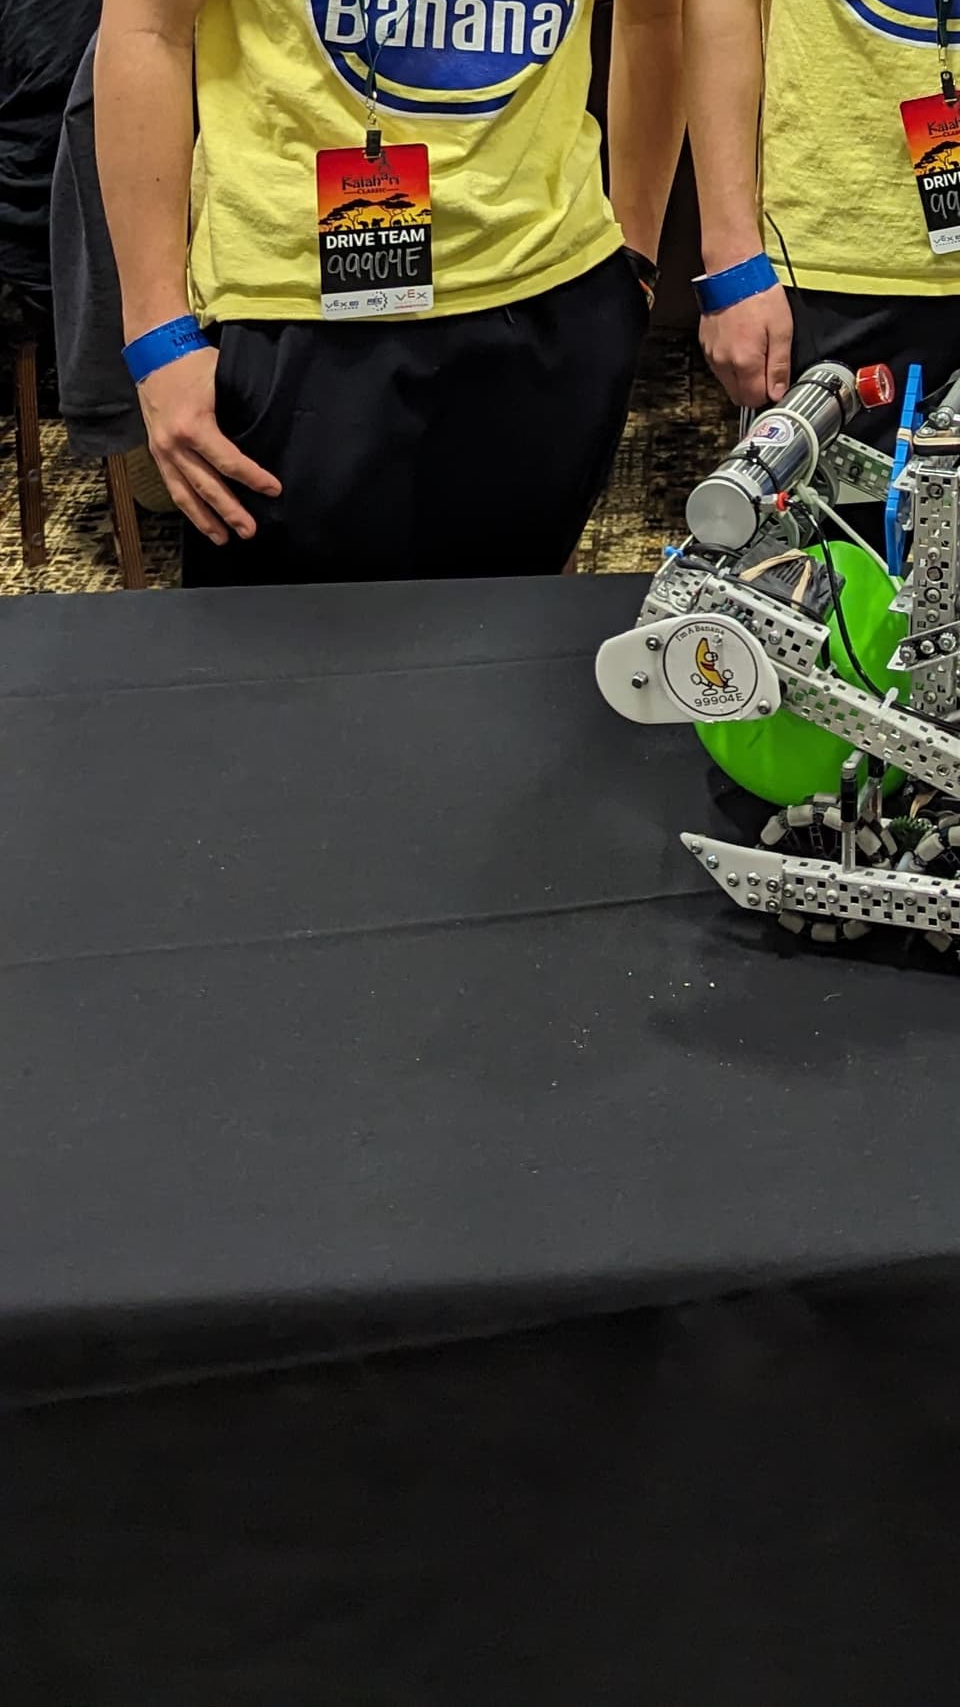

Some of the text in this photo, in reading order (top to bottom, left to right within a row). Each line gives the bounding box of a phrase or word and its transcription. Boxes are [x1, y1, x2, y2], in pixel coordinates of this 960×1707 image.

[326, 228, 426, 250] DRIVE TEAM
[326, 246, 423, 282] 99904E
[694, 692, 745, 708] 99904E
